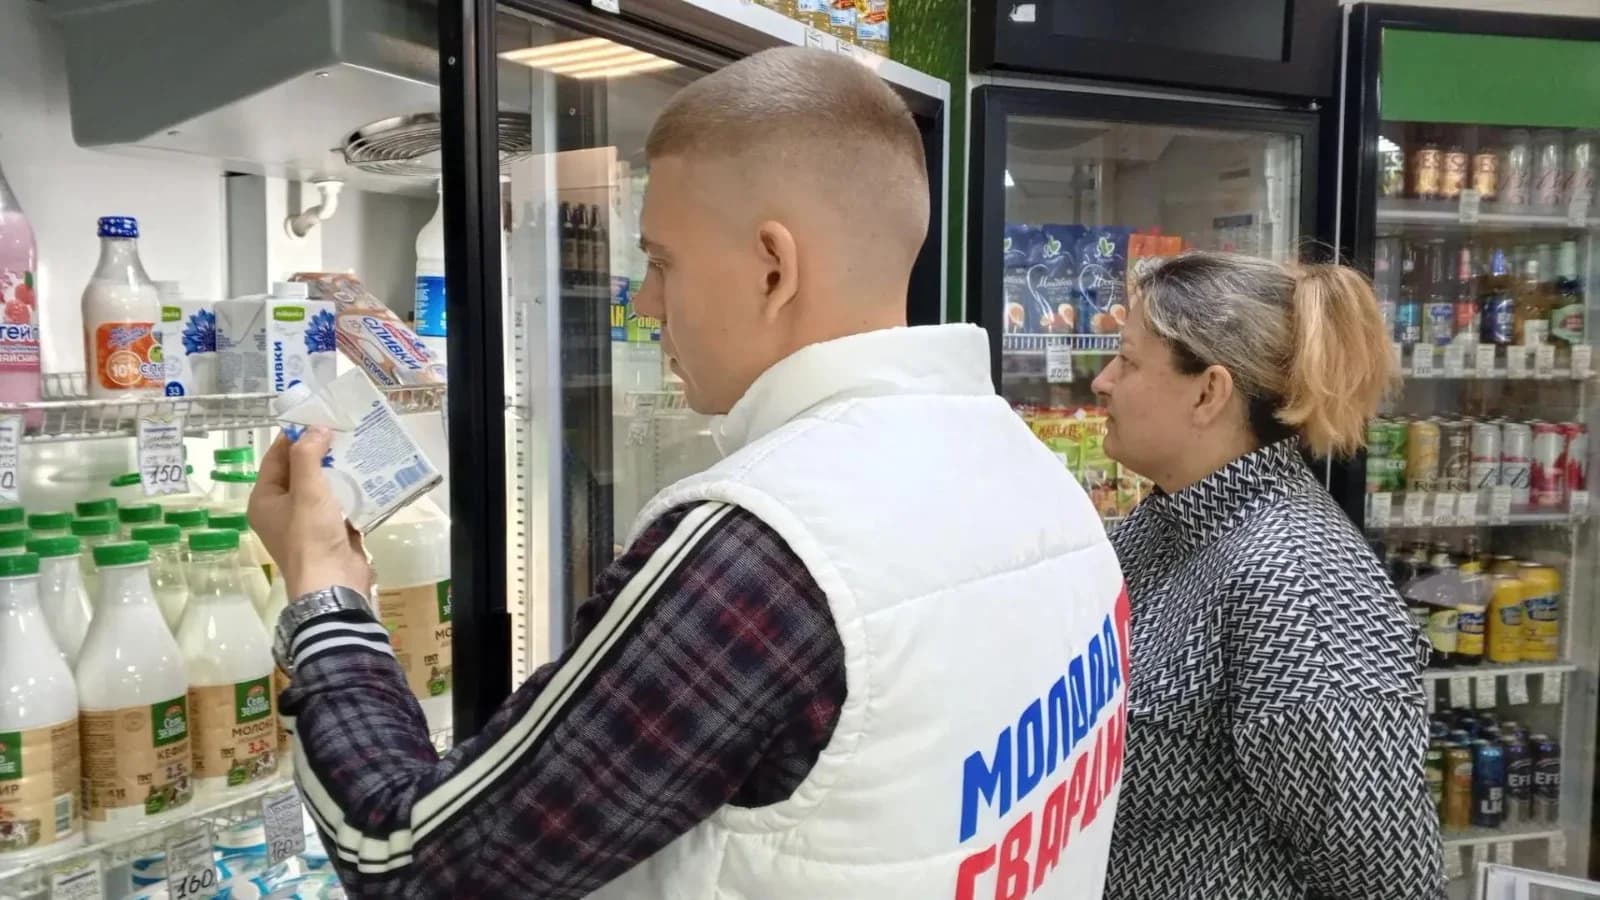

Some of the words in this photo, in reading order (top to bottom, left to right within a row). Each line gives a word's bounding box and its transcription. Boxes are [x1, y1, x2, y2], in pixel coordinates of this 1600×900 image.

[362, 316, 421, 370] СЛИВКИ
[150, 464, 182, 485] 150
[177, 867, 214, 899] 160
